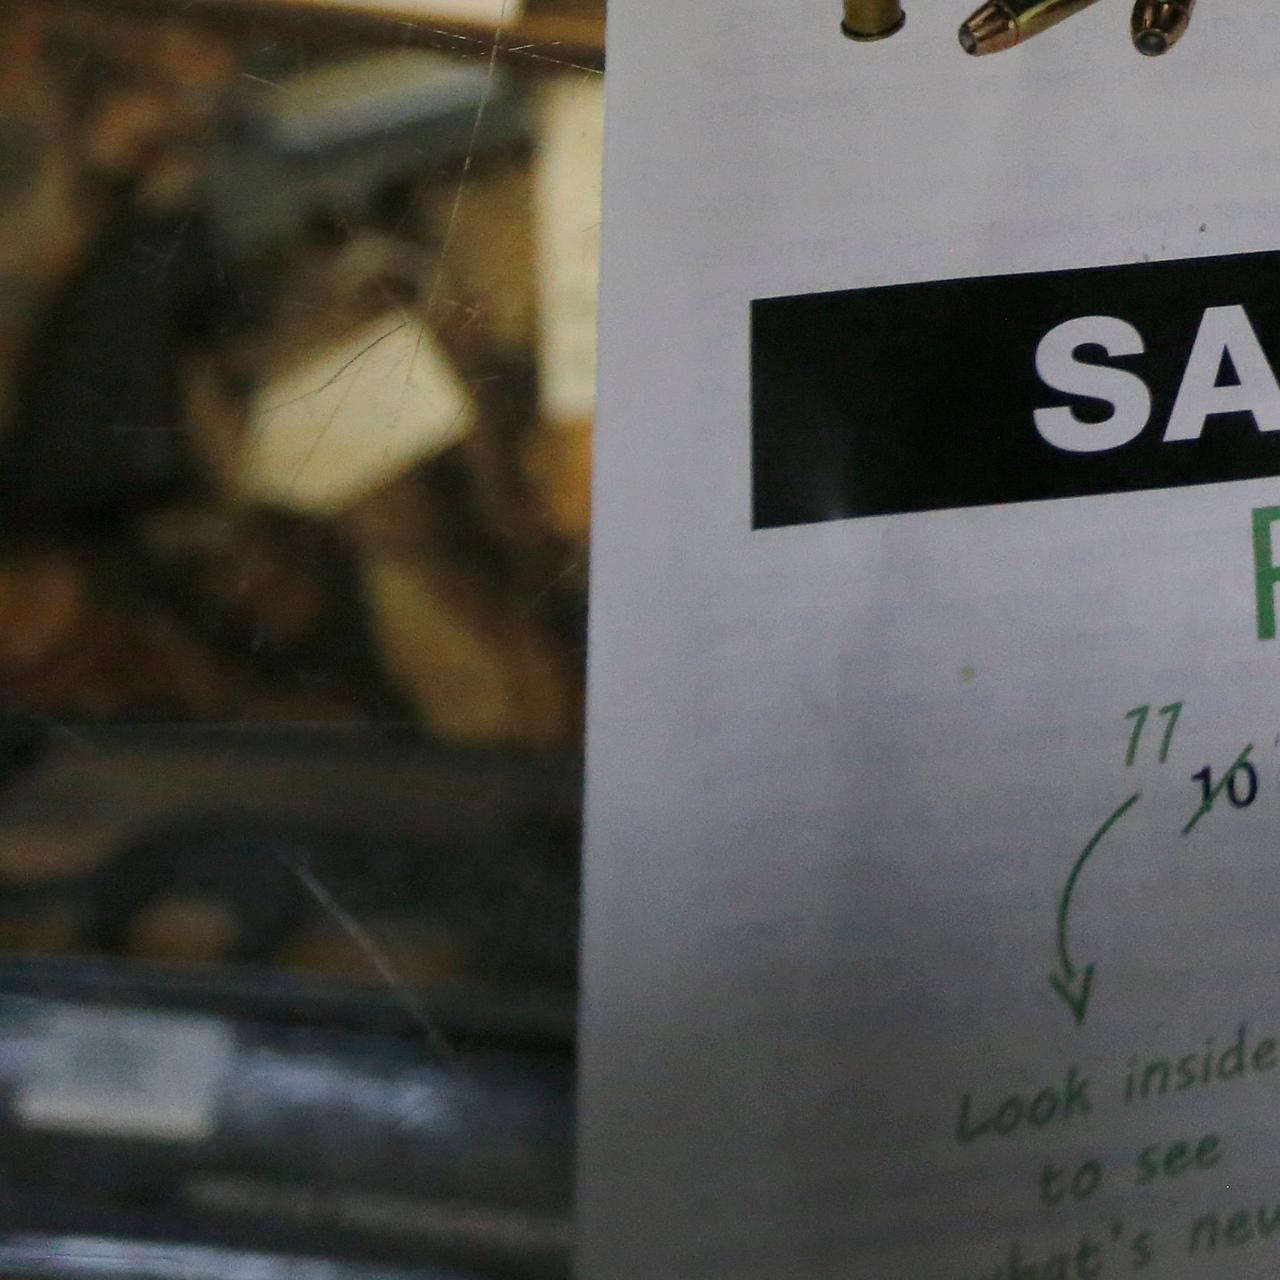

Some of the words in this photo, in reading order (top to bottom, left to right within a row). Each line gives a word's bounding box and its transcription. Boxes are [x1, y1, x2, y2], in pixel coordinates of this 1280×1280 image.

[955, 1063, 1094, 1146] Look
[1039, 1157, 1102, 1206] to
[1136, 1131, 1223, 1187] see
[992, 1217, 1154, 1280] hat's
